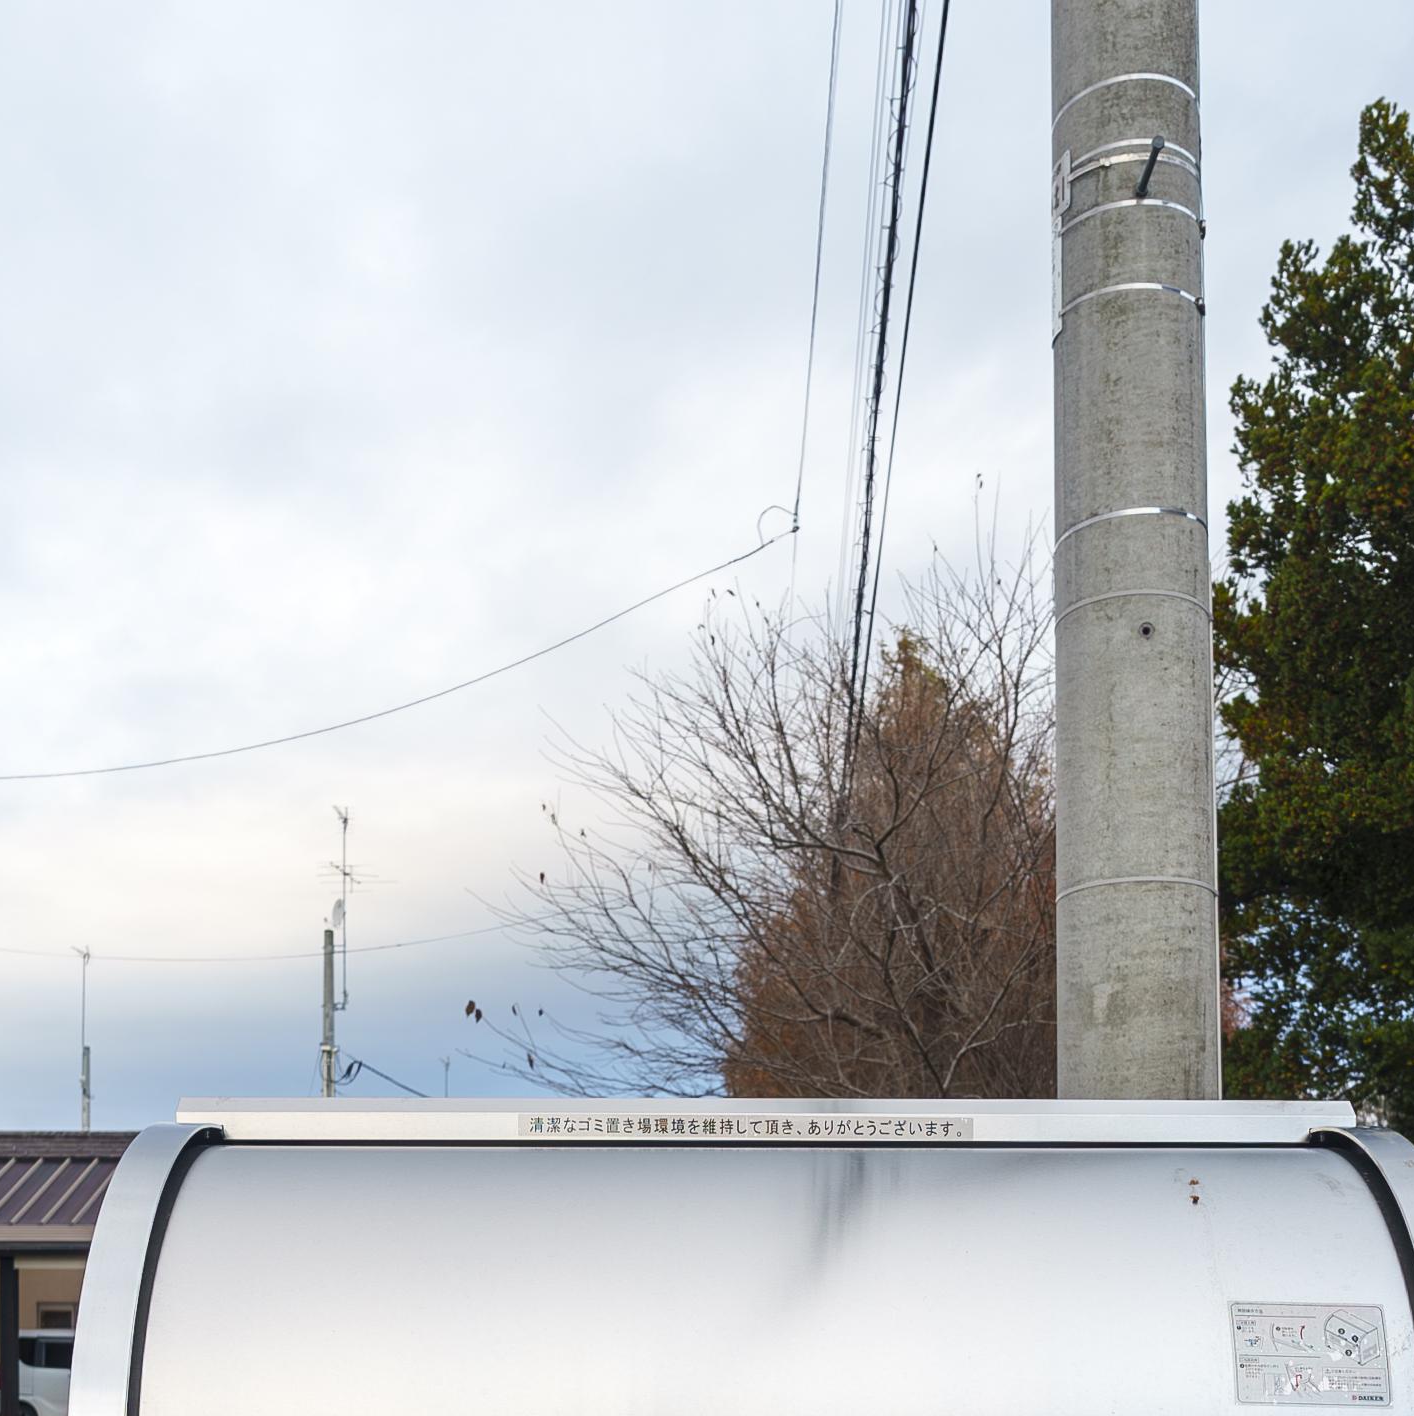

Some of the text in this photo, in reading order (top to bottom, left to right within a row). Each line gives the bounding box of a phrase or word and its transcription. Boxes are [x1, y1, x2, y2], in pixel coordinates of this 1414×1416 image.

[529, 1116, 963, 1138] 清潔なゴミ置き場環境を維持して頂き、ありがとうございます。
